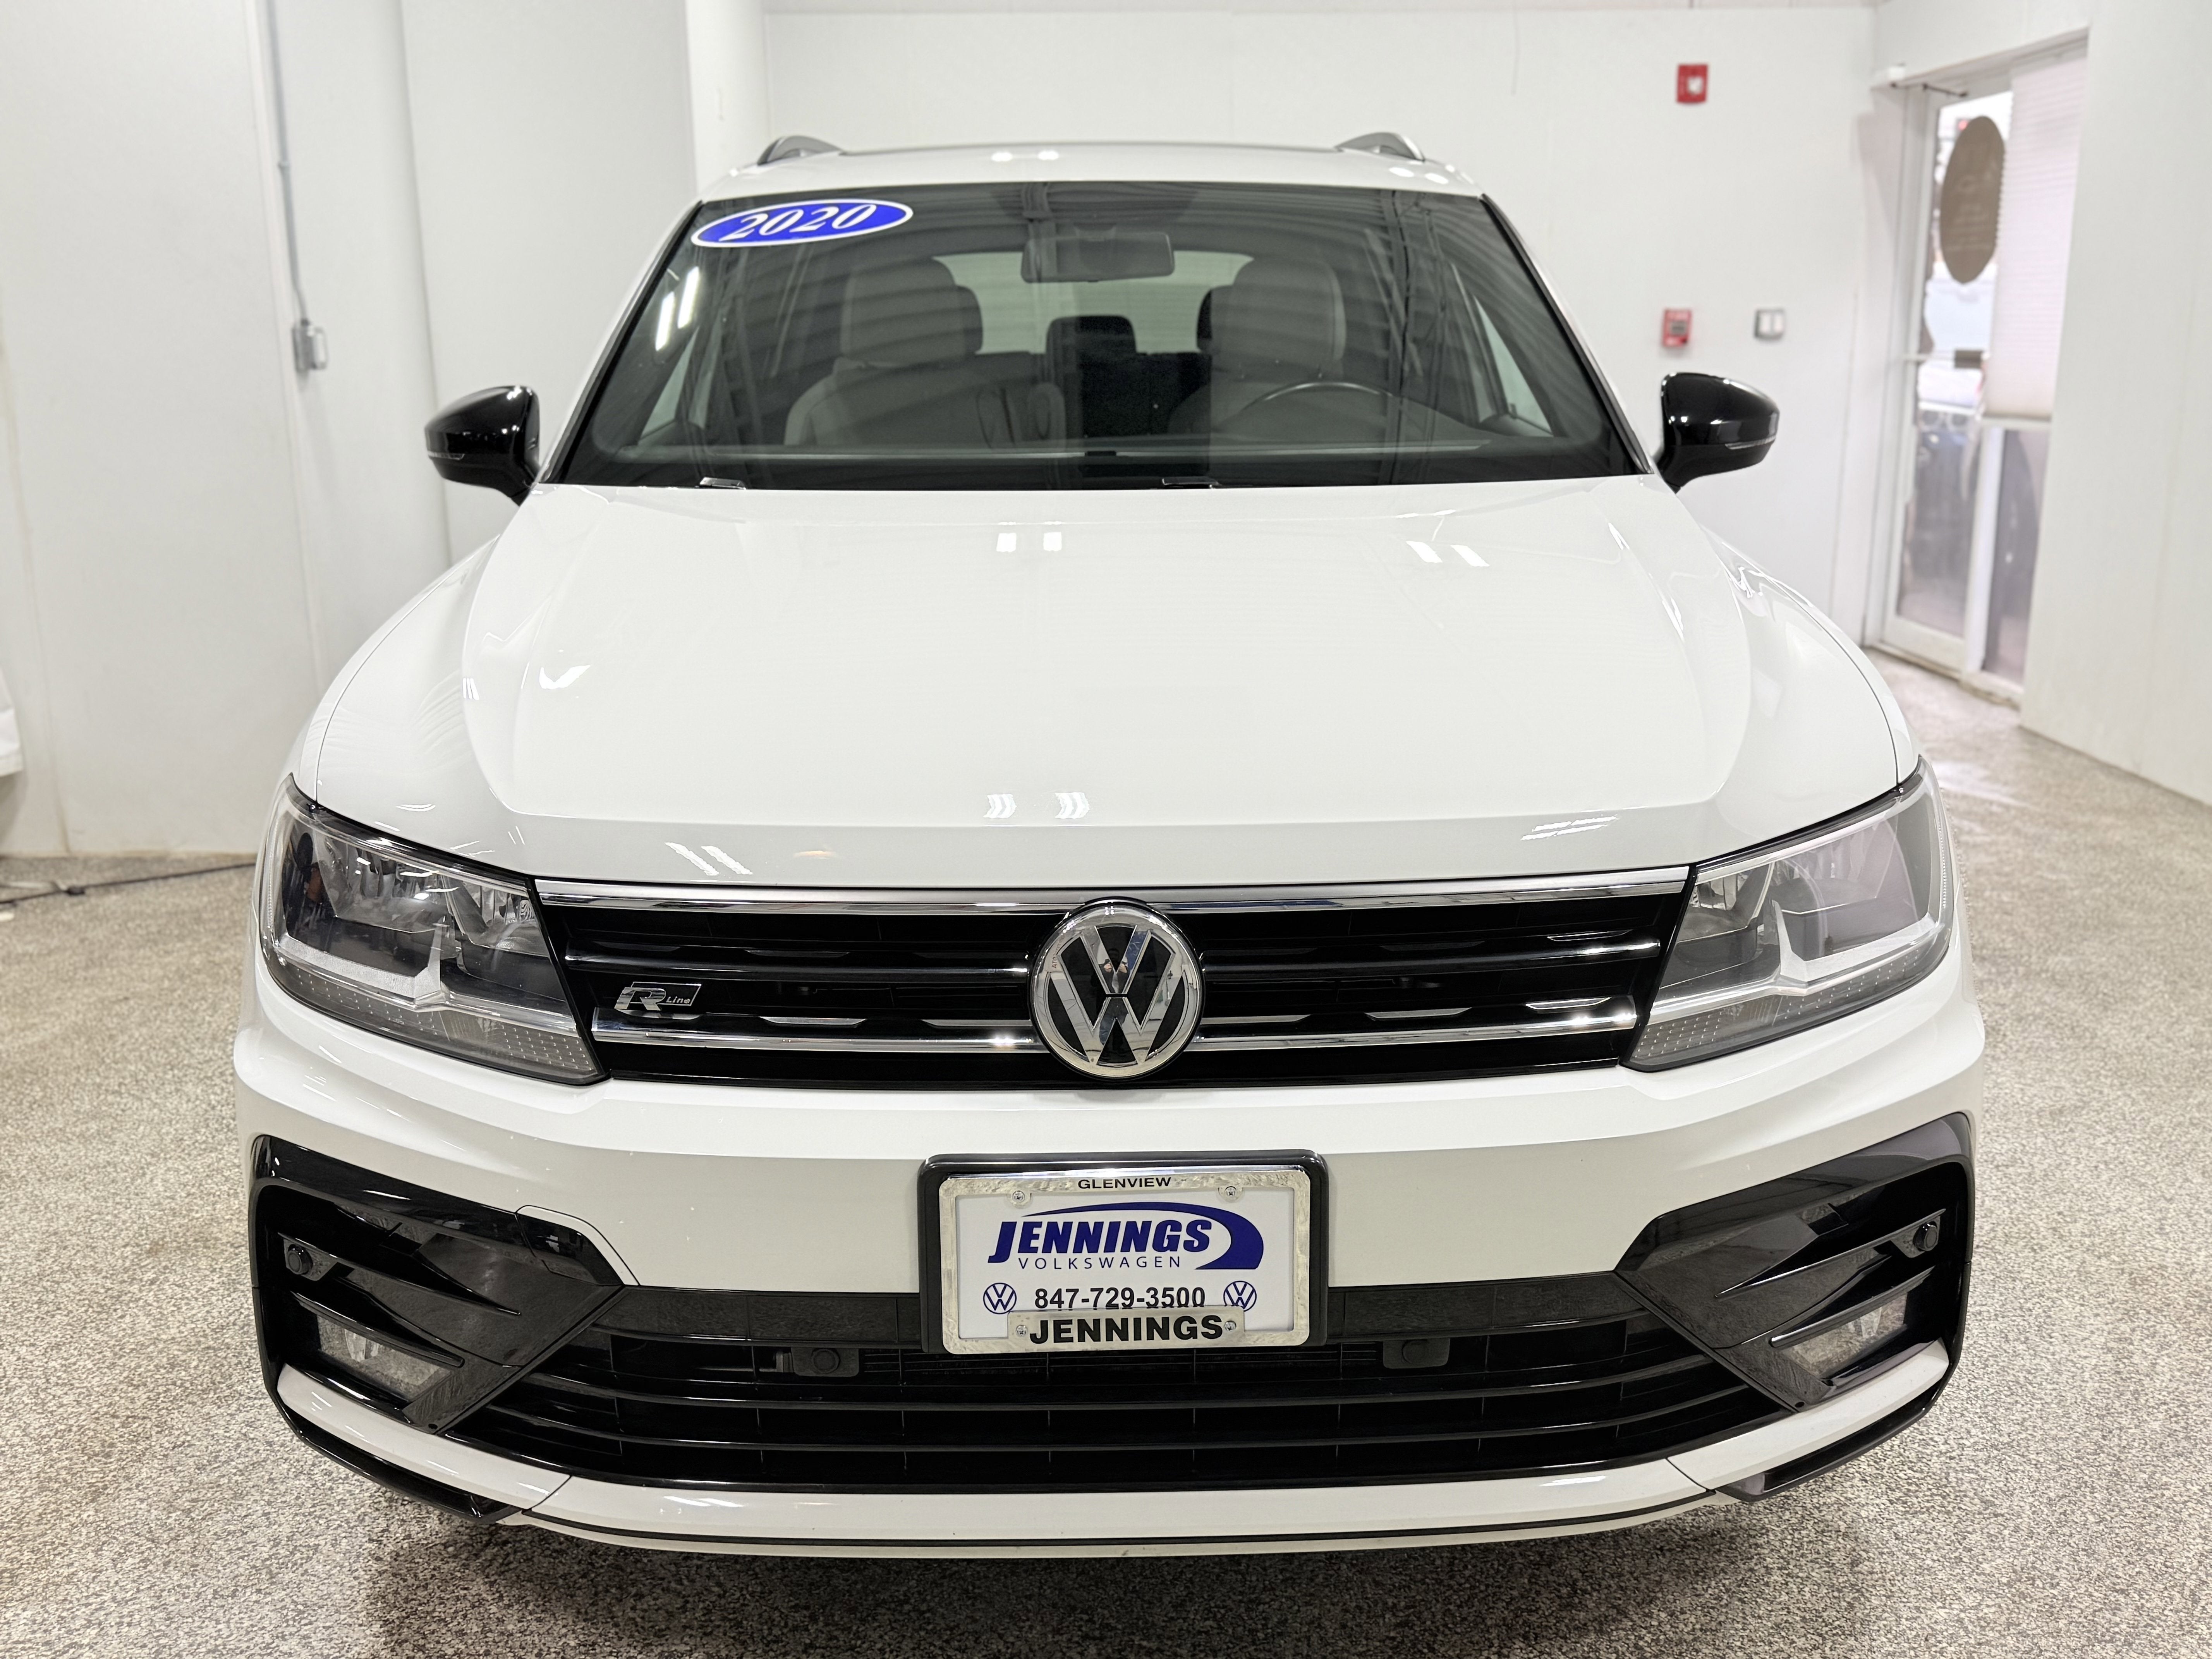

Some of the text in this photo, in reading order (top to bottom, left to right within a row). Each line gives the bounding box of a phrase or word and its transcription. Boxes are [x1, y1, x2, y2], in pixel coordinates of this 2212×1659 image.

[719, 204, 877, 241] 2020
[614, 987, 666, 1011] R
[1078, 1177, 1171, 1189] GLENVIEW
[988, 1219, 1212, 1263] JENNINGS
[1018, 1256, 1180, 1269] VOLKSWAGEN
[1034, 1287, 1206, 1309] 847-729-3500
[1029, 1315, 1223, 1345] JENNINGS
